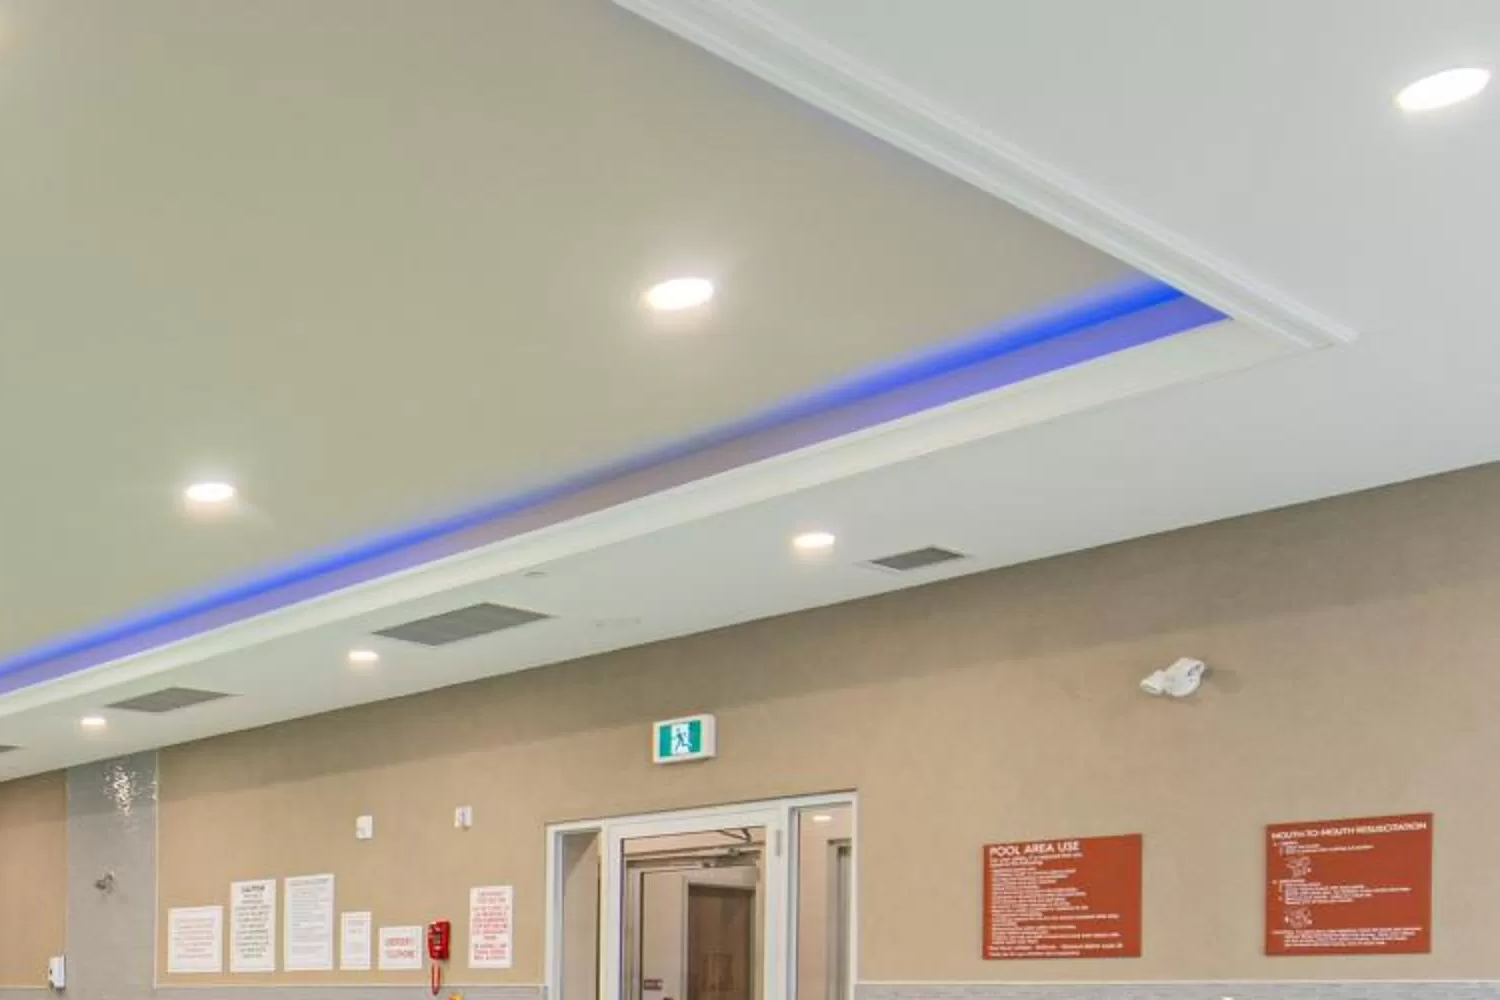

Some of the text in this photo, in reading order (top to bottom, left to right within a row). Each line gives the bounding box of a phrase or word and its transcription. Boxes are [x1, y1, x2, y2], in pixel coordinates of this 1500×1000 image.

[989, 840, 1080, 857] POOL AREA USE
